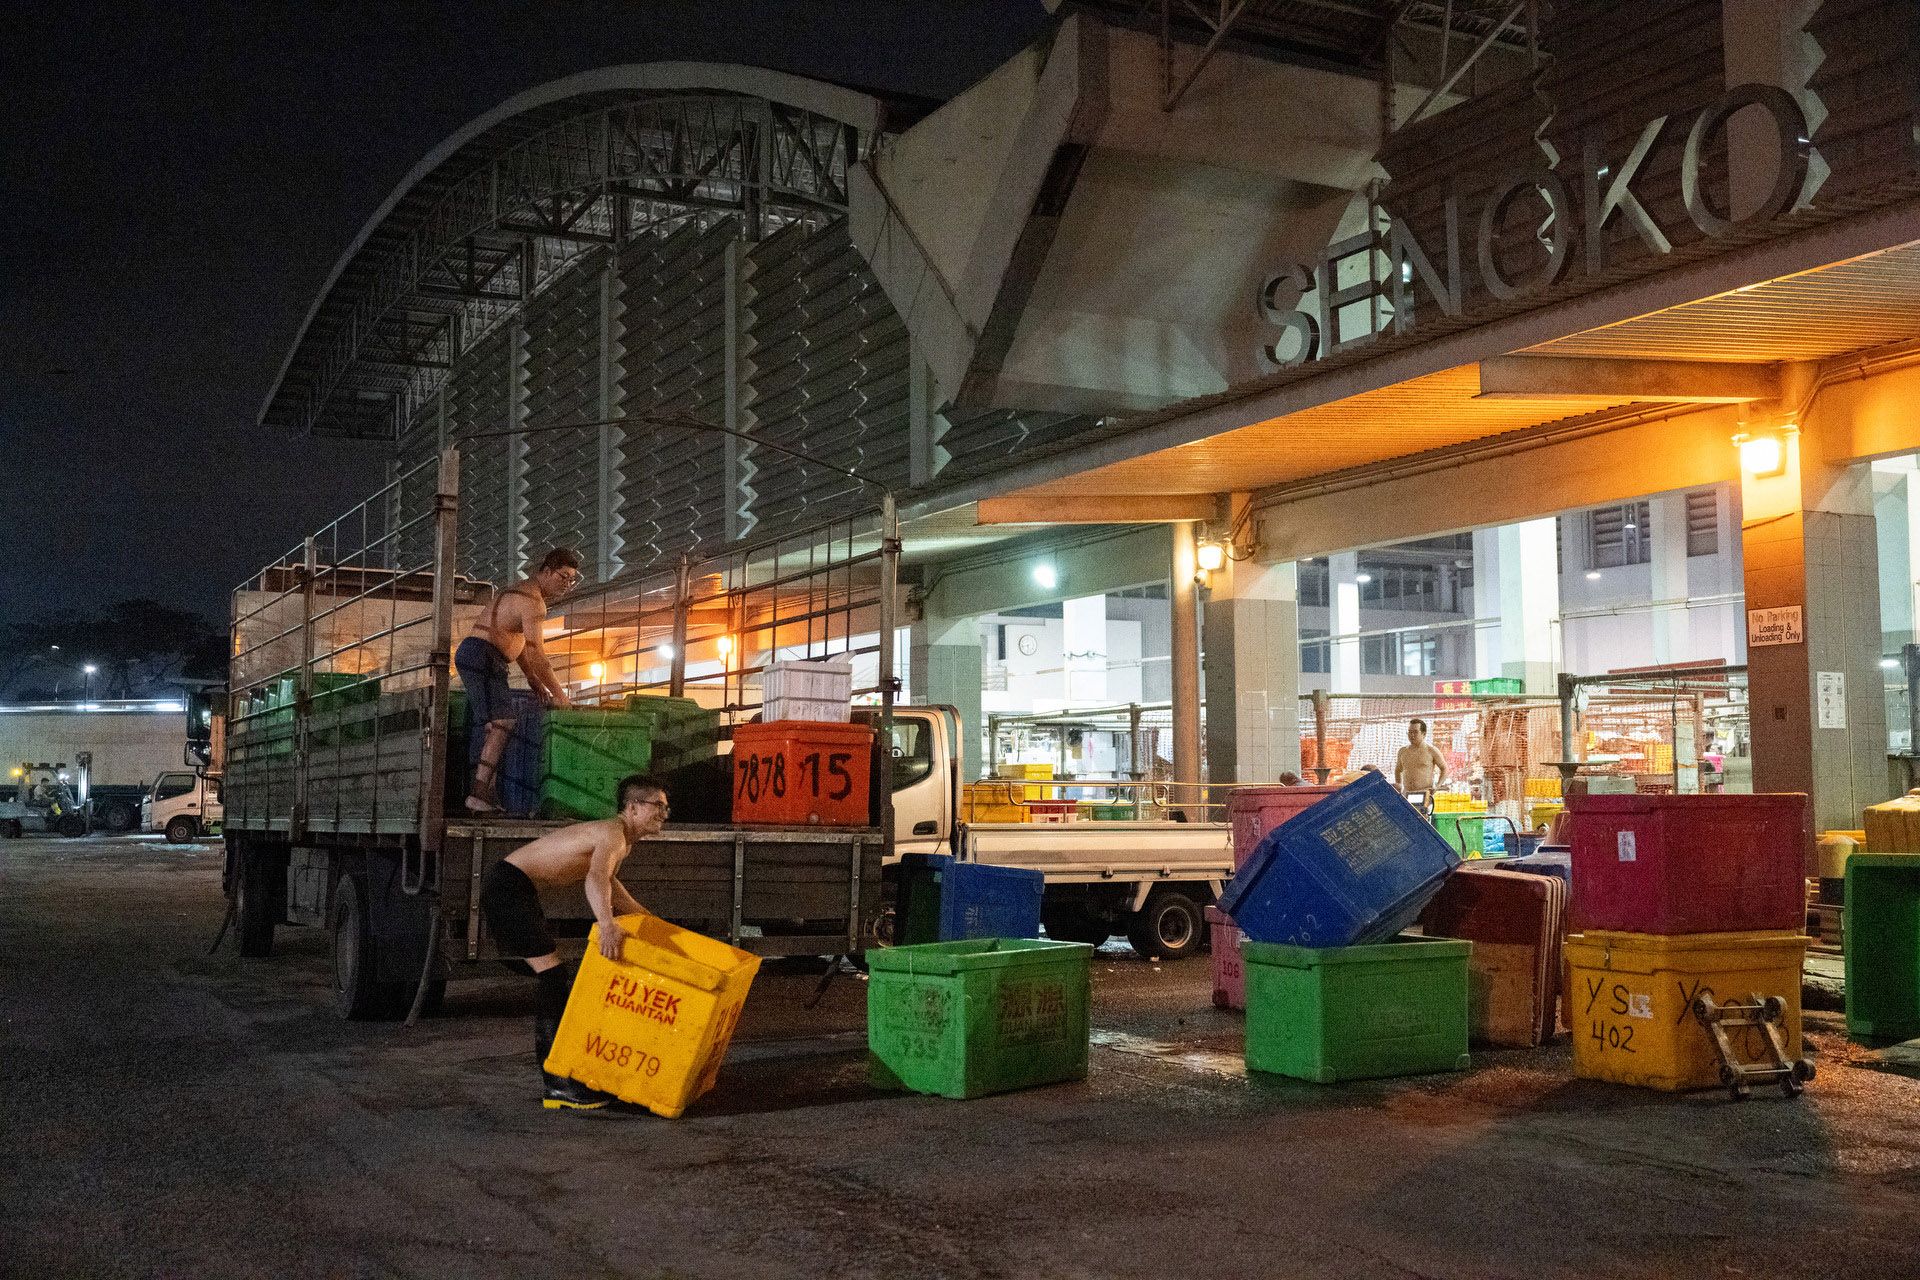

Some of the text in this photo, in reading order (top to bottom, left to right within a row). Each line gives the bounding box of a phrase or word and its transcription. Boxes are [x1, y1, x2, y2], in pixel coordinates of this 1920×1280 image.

[1260, 83, 1811, 369] SENOKO
[1752, 609, 1799, 624] No Parking
[1759, 622, 1792, 634] Loading &
[1751, 630, 1801, 643] Unloading Only
[738, 752, 787, 803] 7878
[605, 991, 676, 1026] KUANTAN
[609, 975, 682, 1015] FU YEK
[1591, 1020, 1636, 1053] 402
[584, 1032, 661, 1077] W3879
